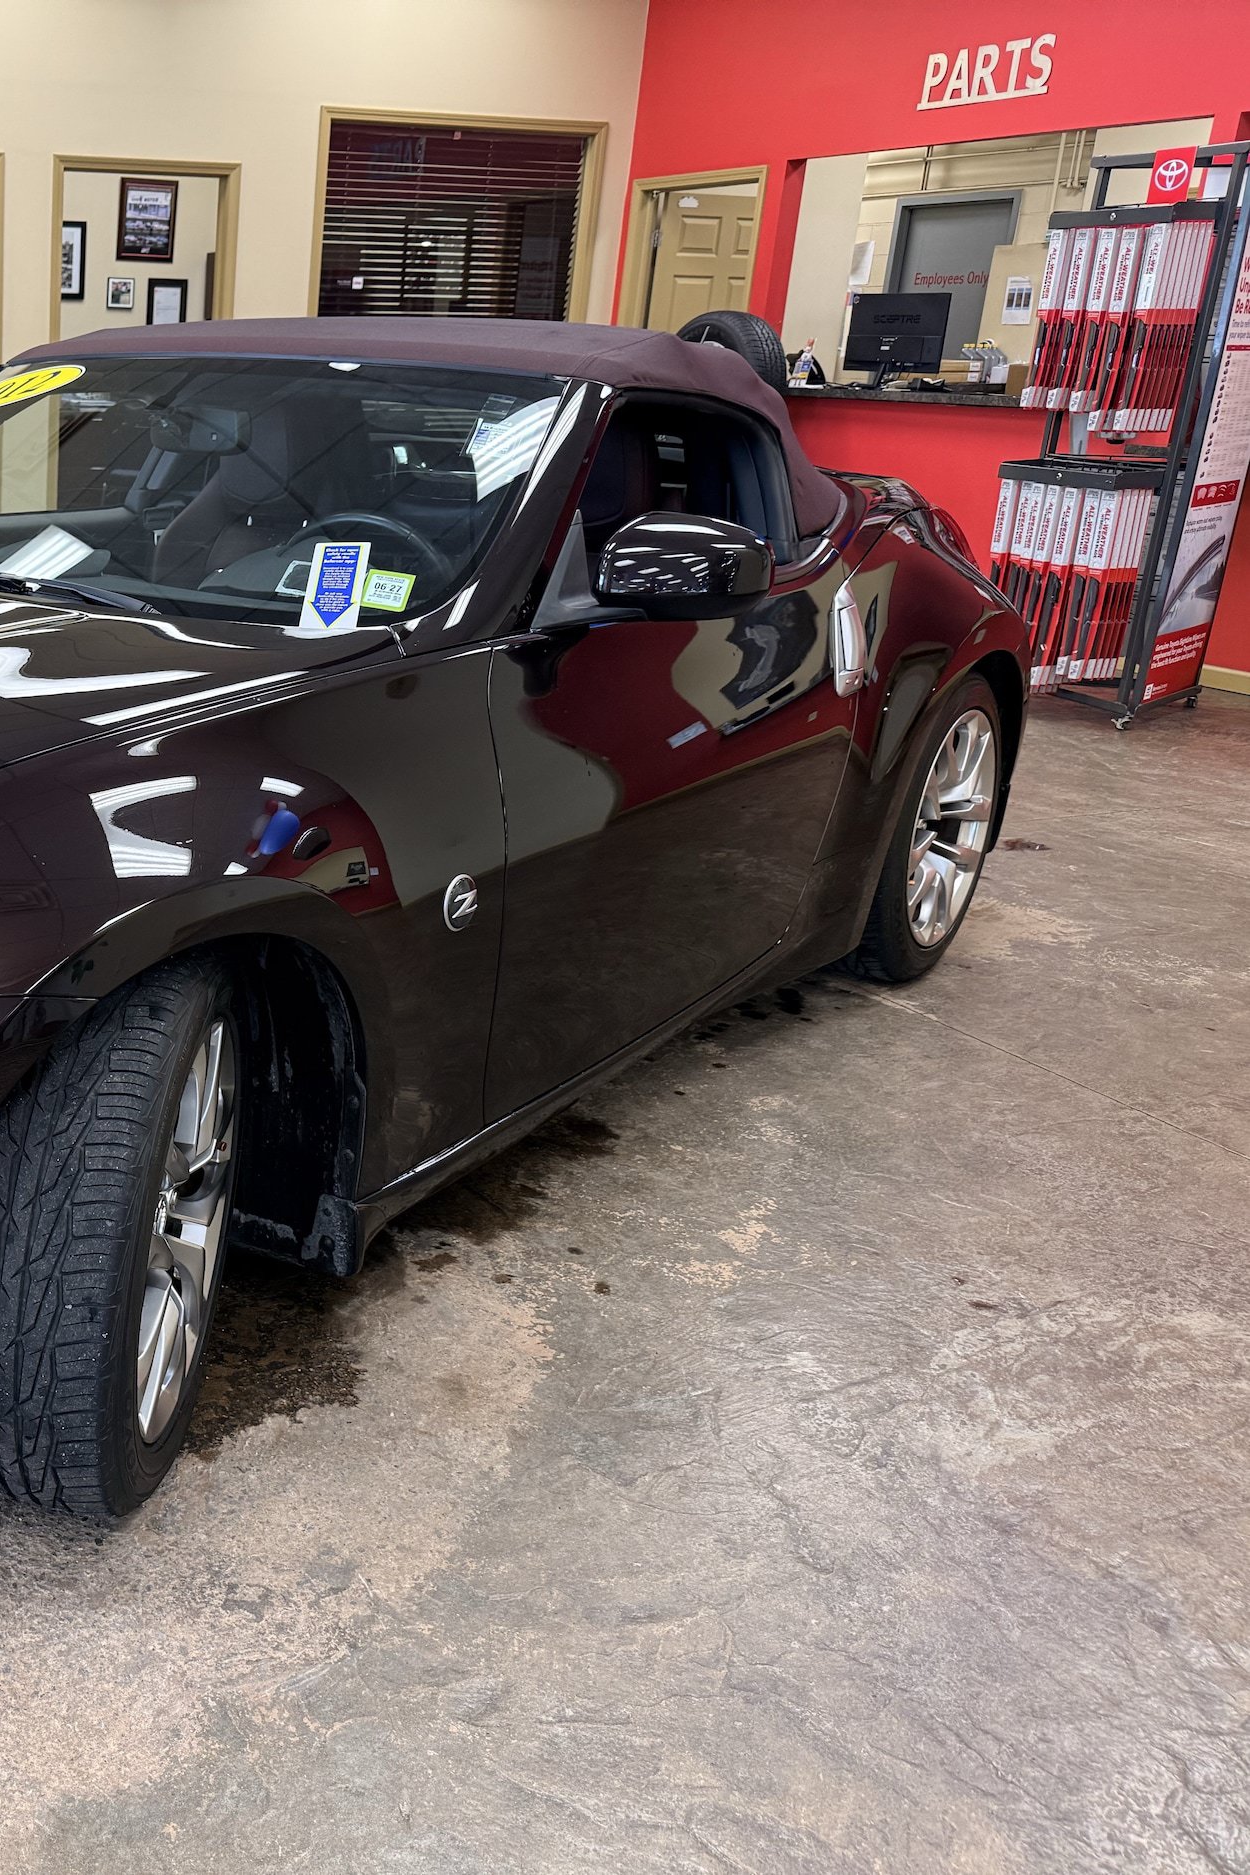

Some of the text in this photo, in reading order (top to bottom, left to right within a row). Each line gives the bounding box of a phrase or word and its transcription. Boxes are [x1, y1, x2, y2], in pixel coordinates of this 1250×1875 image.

[920, 33, 1056, 107] PARTS
[914, 271, 989, 288] Employees Only
[1070, 247, 1084, 300] ALL-WEATHER
[1095, 246, 1110, 300] ALL-WEATHER
[1118, 246, 1133, 301] ALL-WEATHER
[873, 314, 921, 325] SCEPTRE
[1057, 504, 1071, 555] ALL-WEATHER
[1081, 504, 1095, 555] ALL-WEATHER
[1097, 507, 1111, 558] ALL-WEATHER
[374, 582, 402, 593] 06 27
[452, 889, 478, 919] Z
